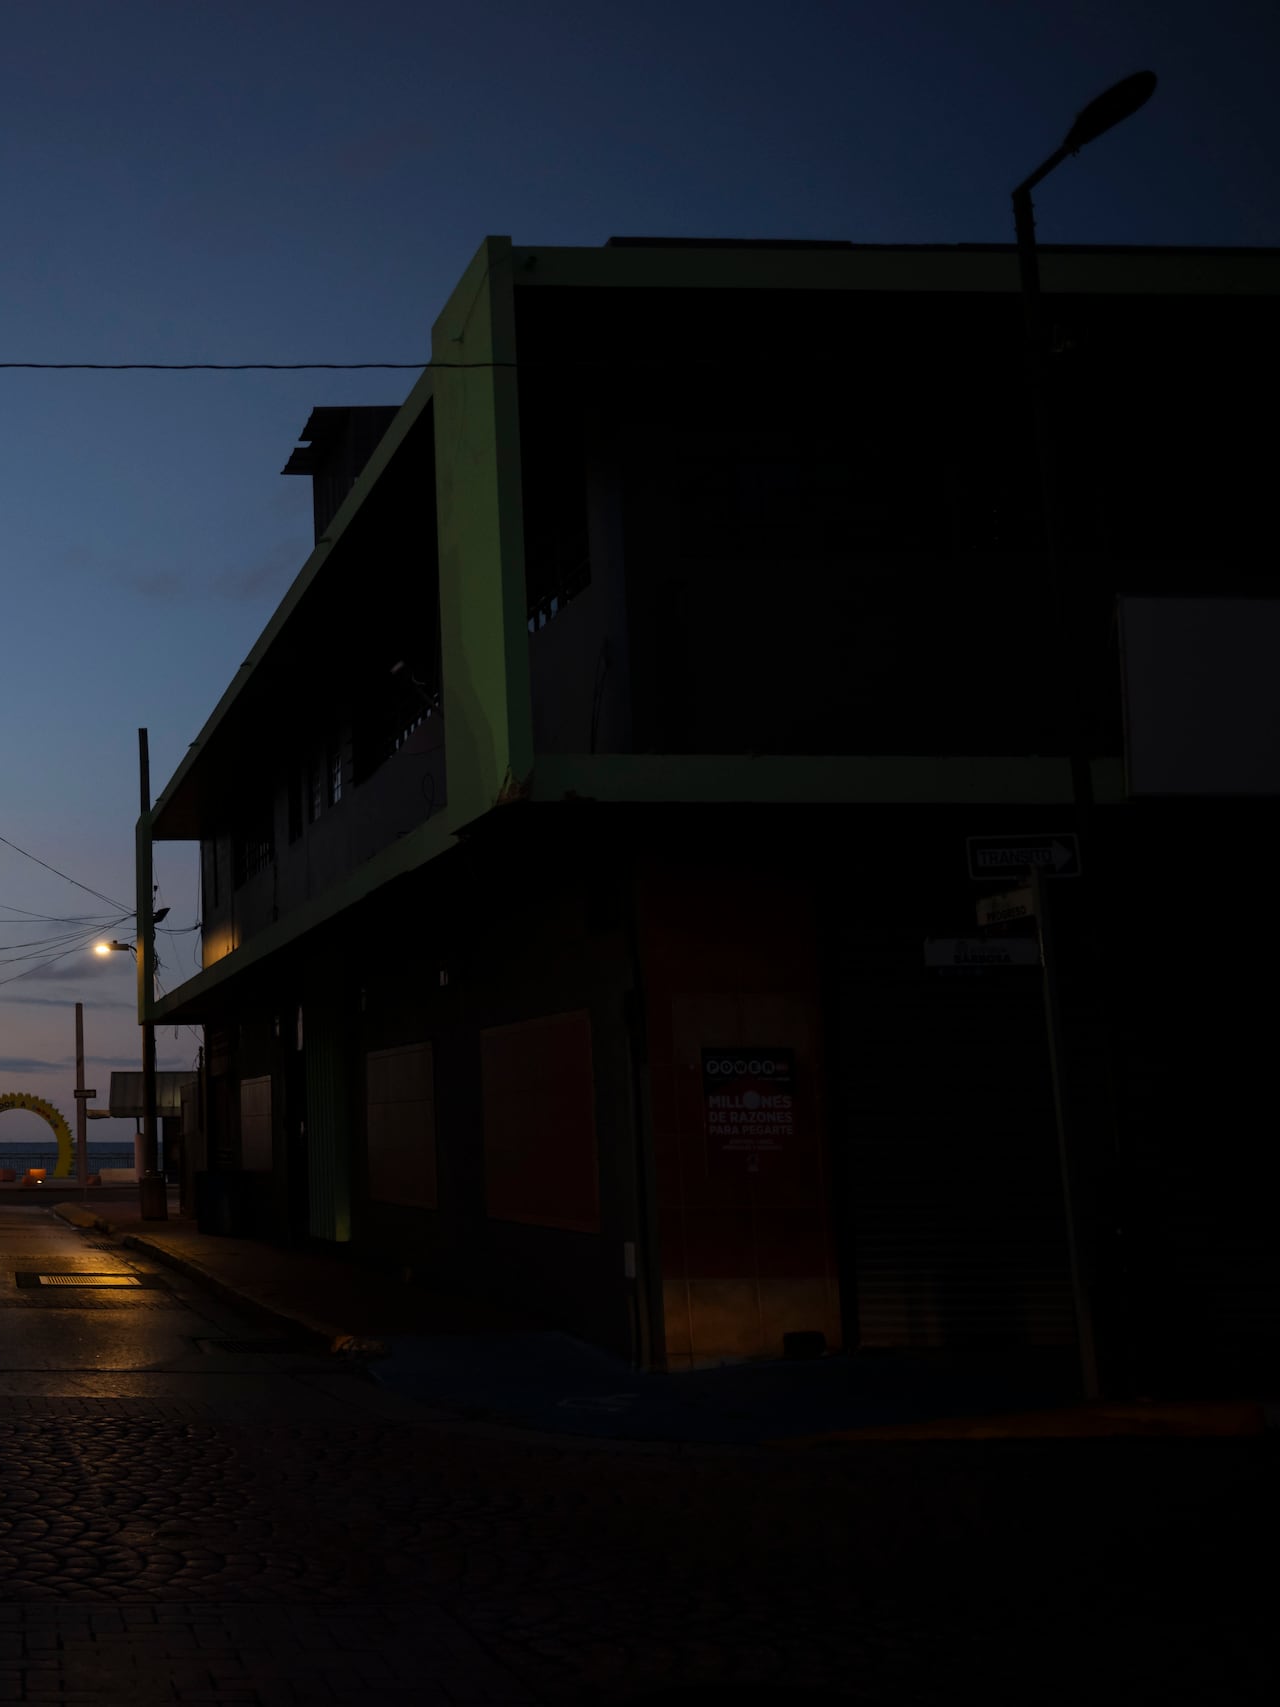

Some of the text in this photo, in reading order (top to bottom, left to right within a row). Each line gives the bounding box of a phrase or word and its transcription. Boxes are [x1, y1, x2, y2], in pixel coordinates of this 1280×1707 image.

[708, 1111, 793, 1123] DE RAZONES
[709, 1125, 793, 1135] PARA PEGARTE
